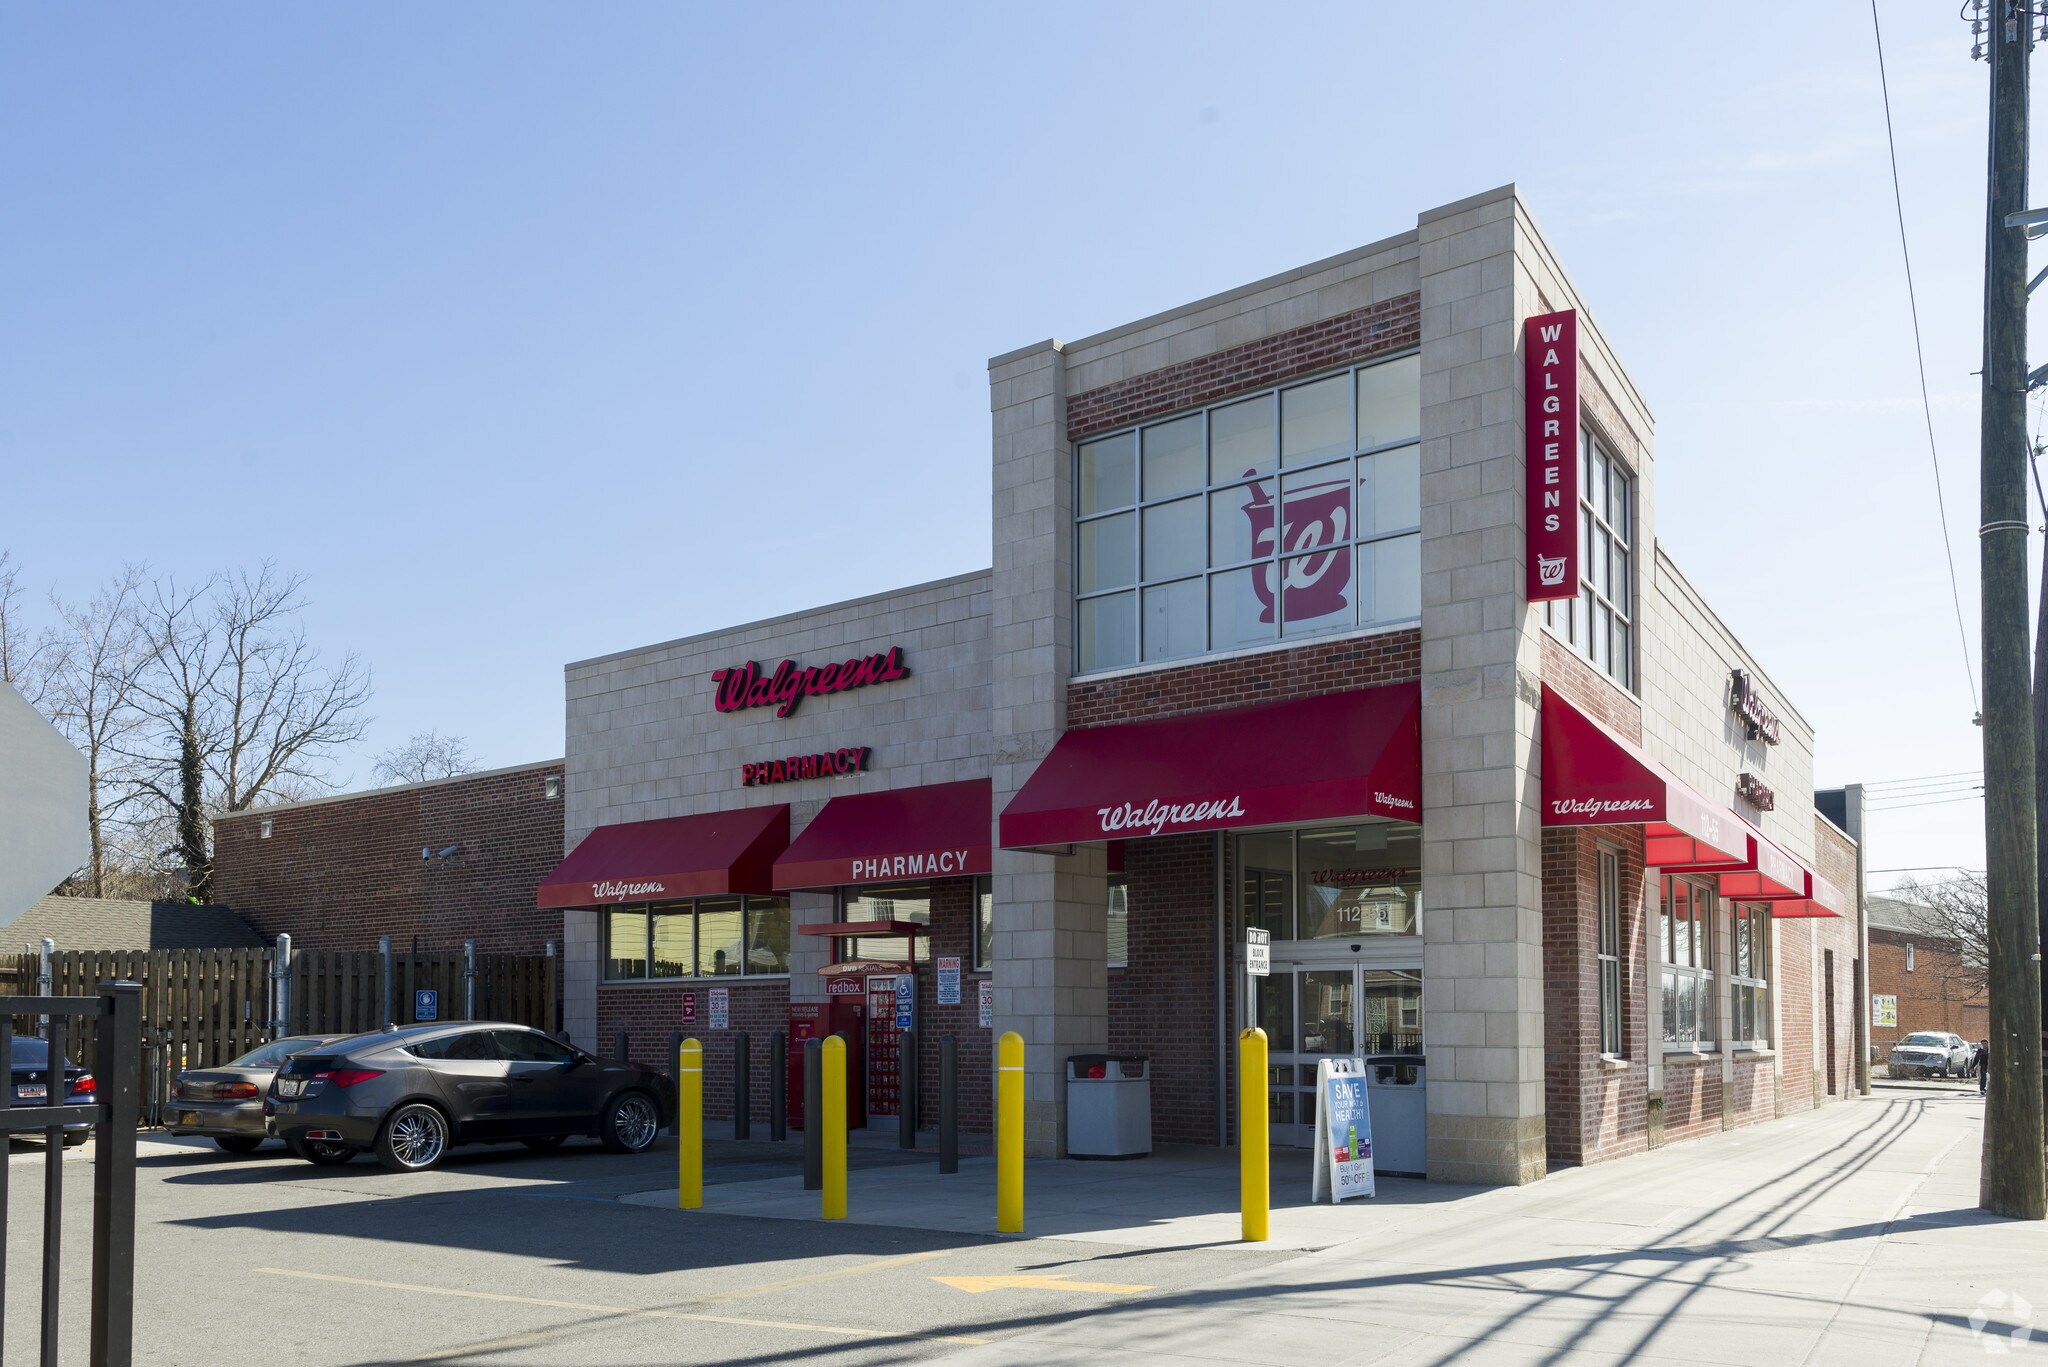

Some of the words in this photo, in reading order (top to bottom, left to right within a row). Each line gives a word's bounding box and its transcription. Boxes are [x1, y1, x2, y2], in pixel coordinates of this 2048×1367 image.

[1540, 323, 1562, 532] WALGREENS
[711, 646, 909, 718] Walgreens
[742, 747, 871, 787] PHARMACY
[1374, 791, 1414, 809] Walgreens
[1551, 798, 1654, 818] Walgreens
[1097, 796, 1245, 835] Walgreens
[853, 851, 969, 880] PHARMACY
[1311, 866, 1408, 887] Walgreens
[592, 879, 665, 901] Walgreens
[1249, 931, 1256, 944] DO
[1257, 932, 1268, 945] NOT
[1252, 948, 1264, 958] BLOCK
[1249, 959, 1268, 970] ENTRANCE
[828, 981, 860, 993] redbox
[981, 996, 992, 1004] 30
[1335, 1083, 1360, 1099] SAVE
[1334, 1100, 1348, 1109] YOUR
[1335, 1109, 1364, 1121] HEALTHY
[1340, 1164, 1350, 1174] Buy
[1353, 1172, 1366, 1184] OFF
